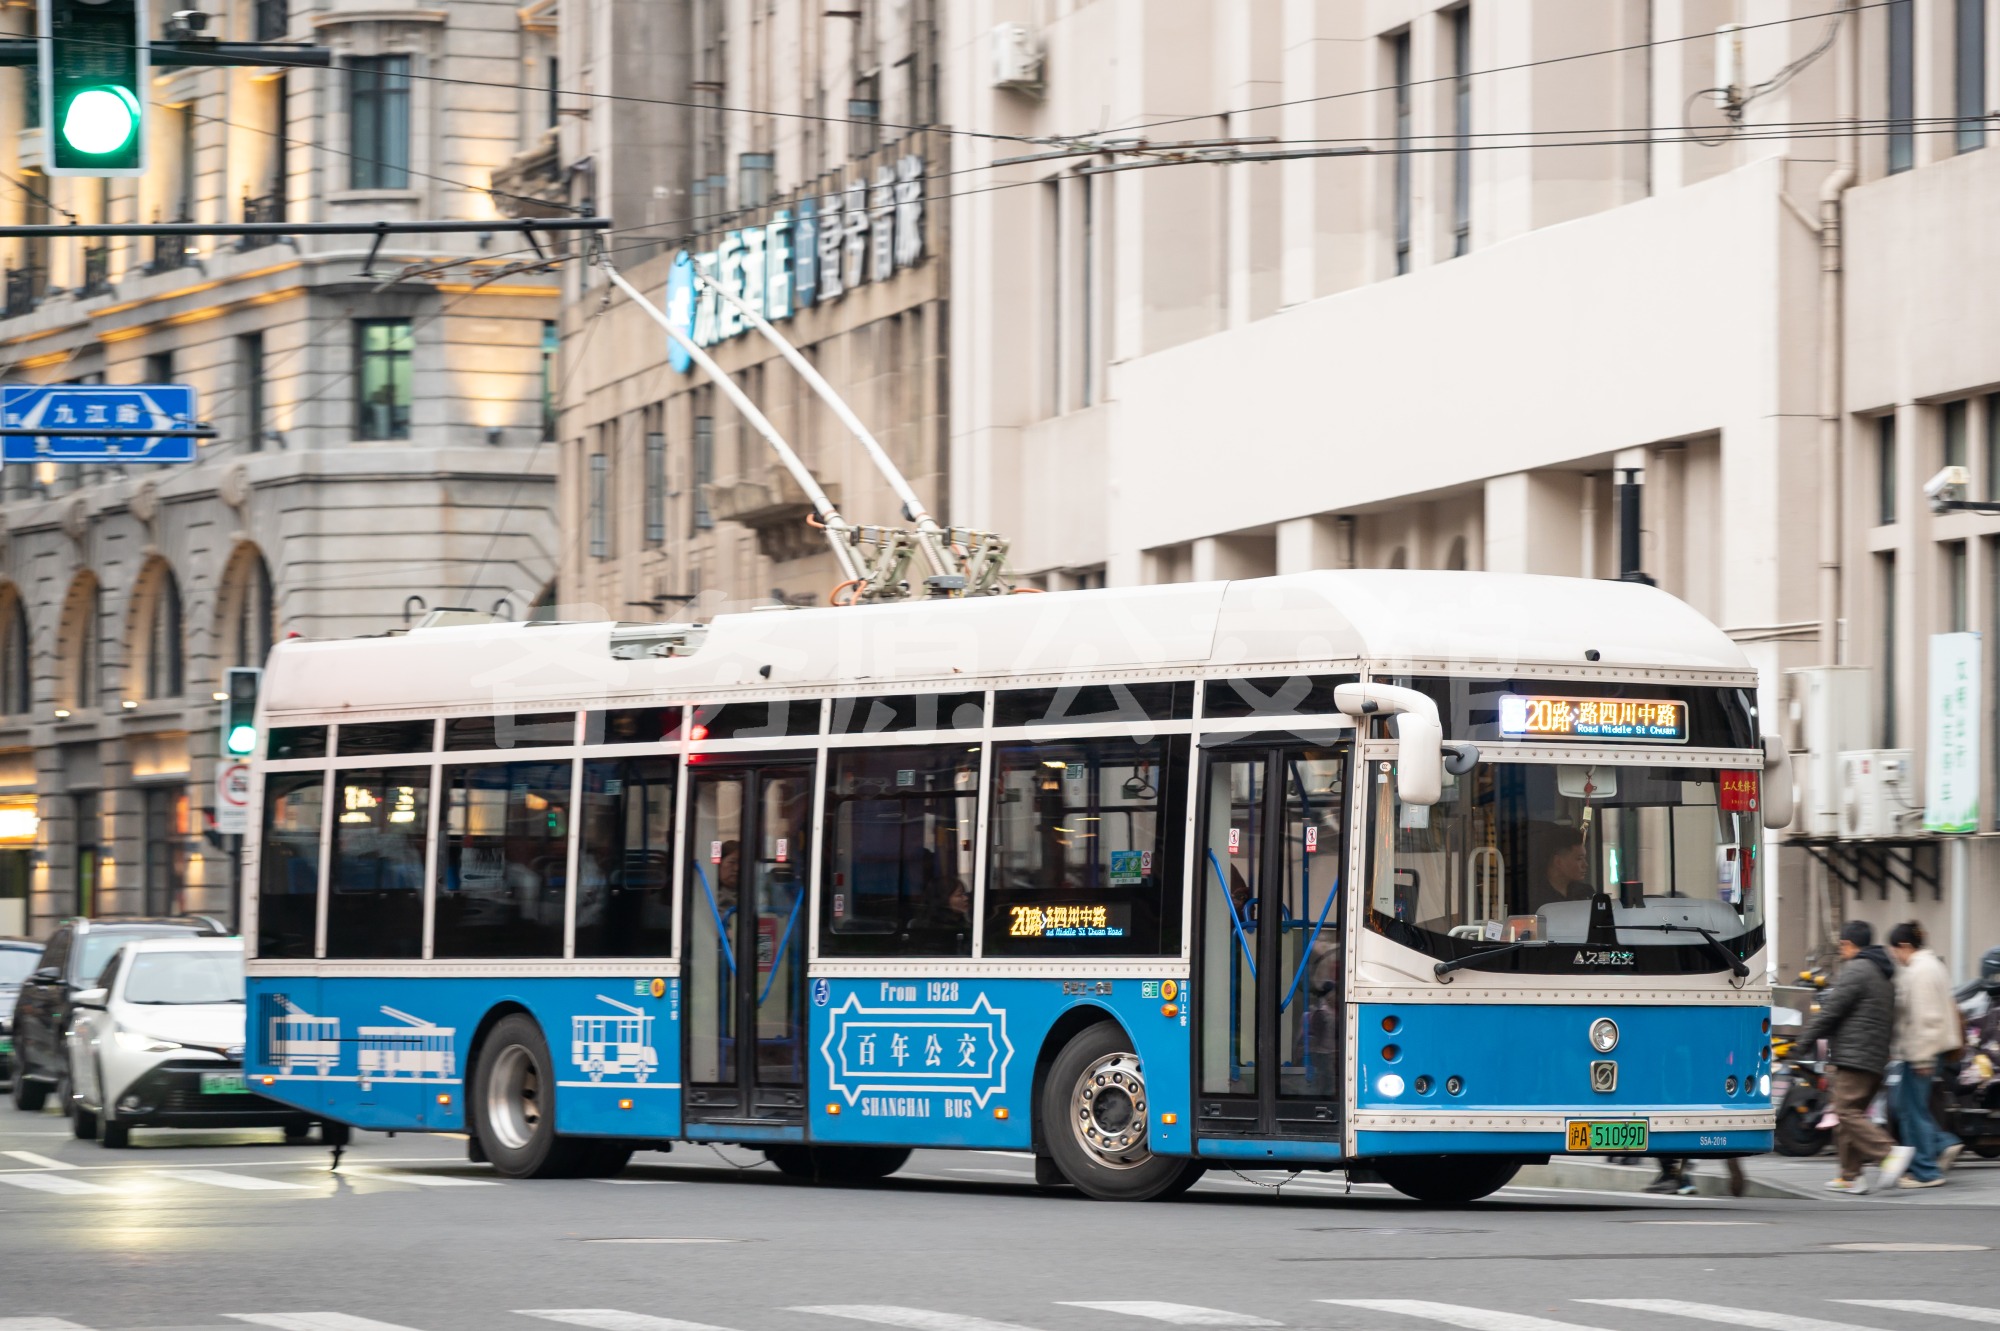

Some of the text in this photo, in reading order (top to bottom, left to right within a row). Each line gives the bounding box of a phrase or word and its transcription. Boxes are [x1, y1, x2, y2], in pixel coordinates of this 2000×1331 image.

[54, 404, 139, 423] 九江路
[1525, 700, 1570, 732] 20路
[1577, 724, 1676, 735] Road Middle Si Chuan
[880, 982, 959, 1002] From 1928
[857, 1032, 977, 1068] 百年公交
[861, 1097, 972, 1119] SHANGHAI BUS
[1700, 1136, 1727, 1147] S5A-2016
